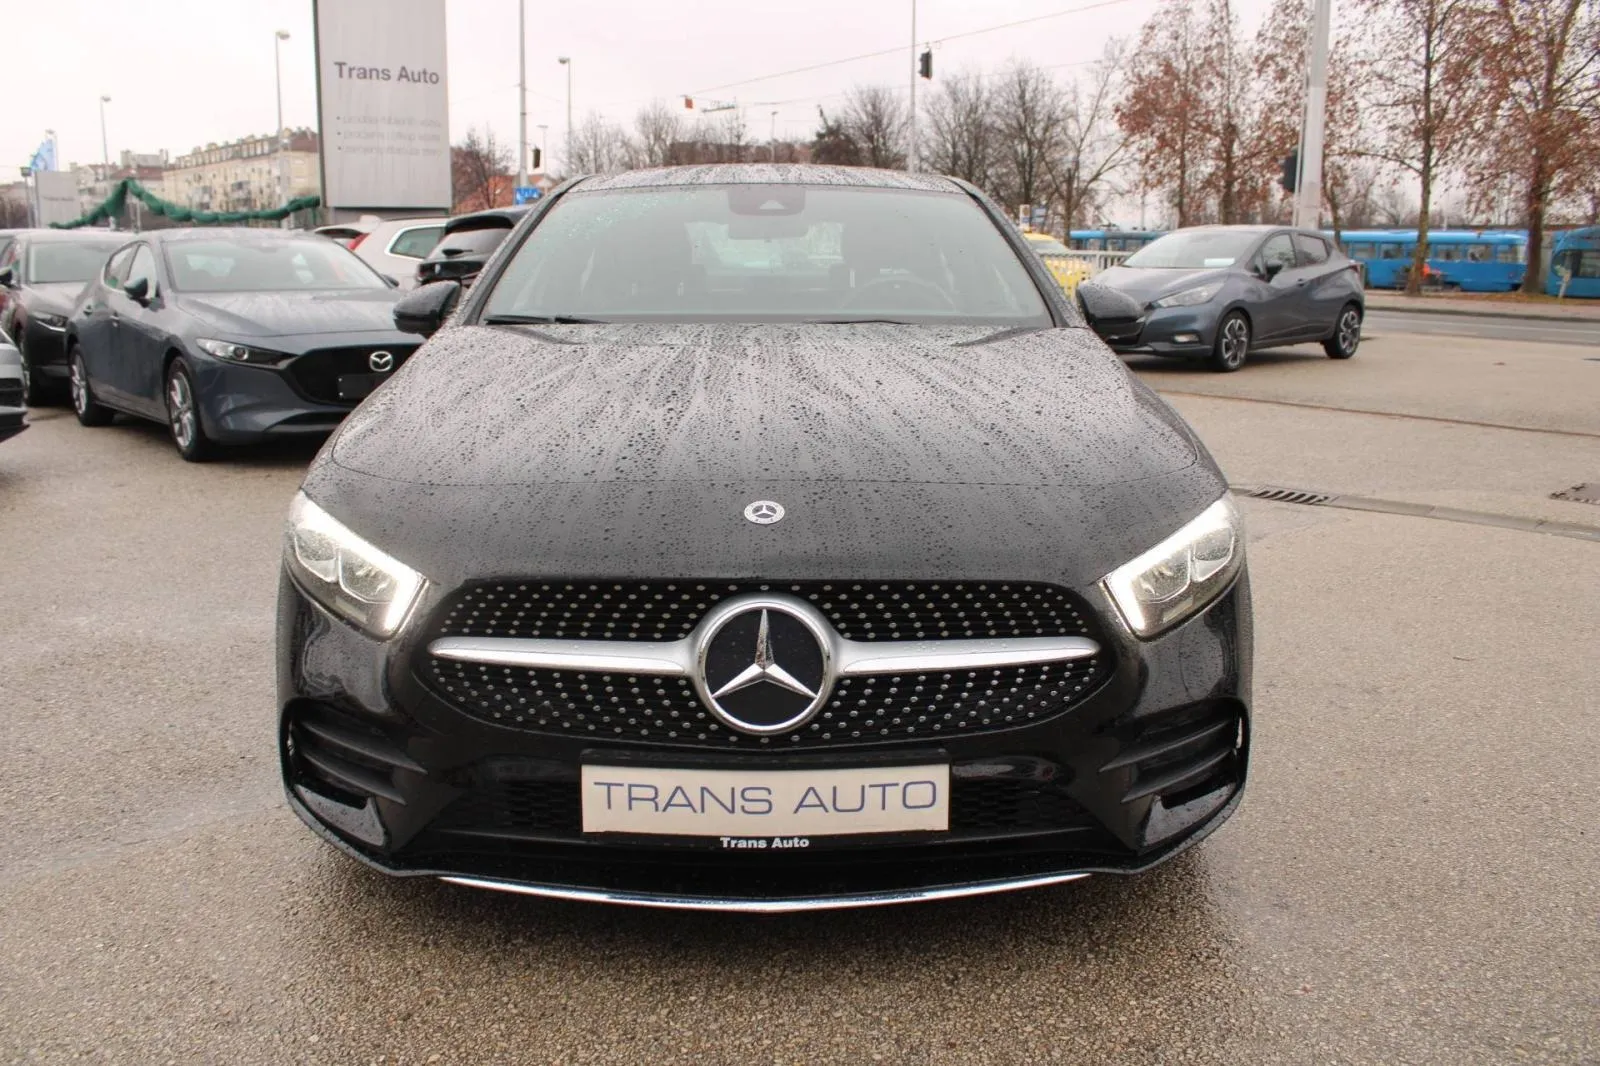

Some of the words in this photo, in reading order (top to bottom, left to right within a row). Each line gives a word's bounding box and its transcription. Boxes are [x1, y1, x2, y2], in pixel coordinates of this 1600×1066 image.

[334, 61, 391, 81] Trans
[397, 66, 439, 84] Auto
[593, 781, 773, 815] TRANS
[793, 780, 937, 814] AUTO
[720, 837, 767, 849] Trans
[771, 837, 810, 848] Auto
